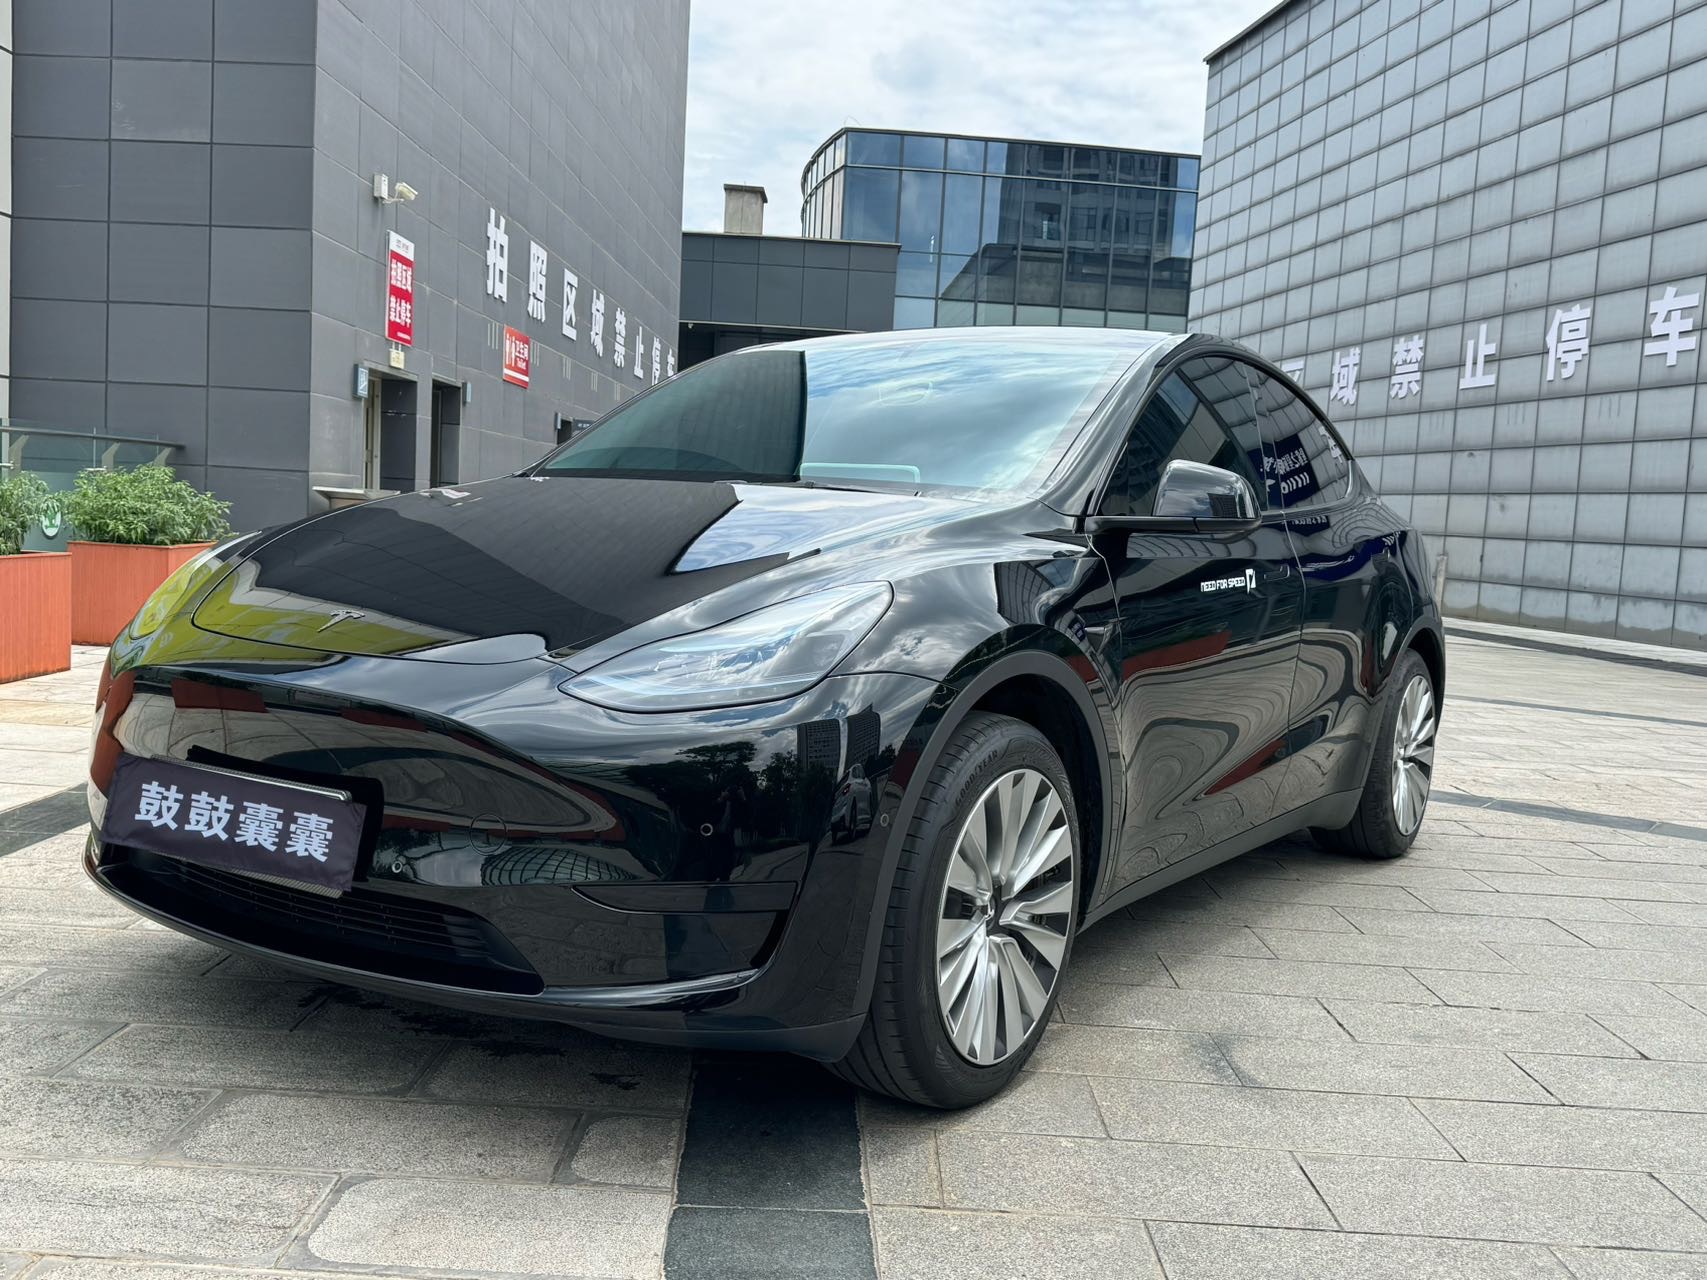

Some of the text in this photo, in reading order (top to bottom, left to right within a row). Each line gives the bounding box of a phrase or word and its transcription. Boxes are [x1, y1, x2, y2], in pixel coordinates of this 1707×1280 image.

[486, 207, 675, 386] 拍照区域禁止停车
[1216, 579, 1228, 590] FOR
[1228, 577, 1246, 588] SPEED
[134, 780, 335, 863] 鼓鼓囊囊
